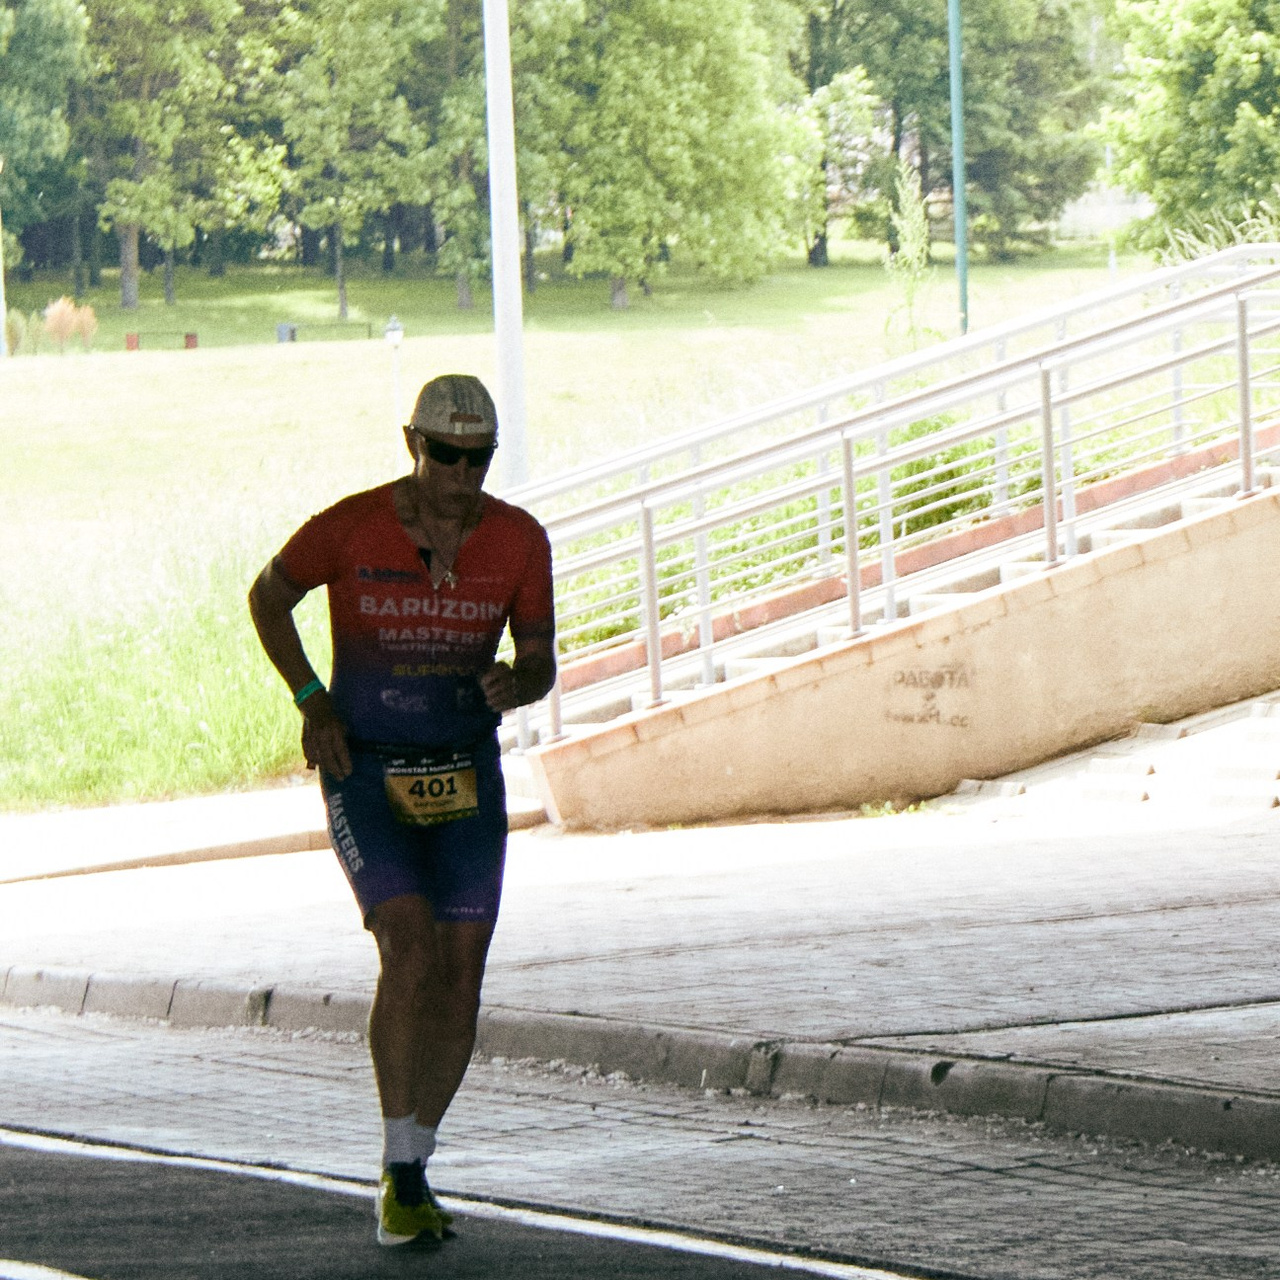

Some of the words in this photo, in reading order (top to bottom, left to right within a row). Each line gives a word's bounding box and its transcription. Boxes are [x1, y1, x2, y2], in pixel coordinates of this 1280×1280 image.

[360, 595, 504, 621] BARUZDIN
[379, 626, 488, 645] MASTERS
[408, 776, 458, 798] 401
[328, 792, 364, 873] MASTERS
